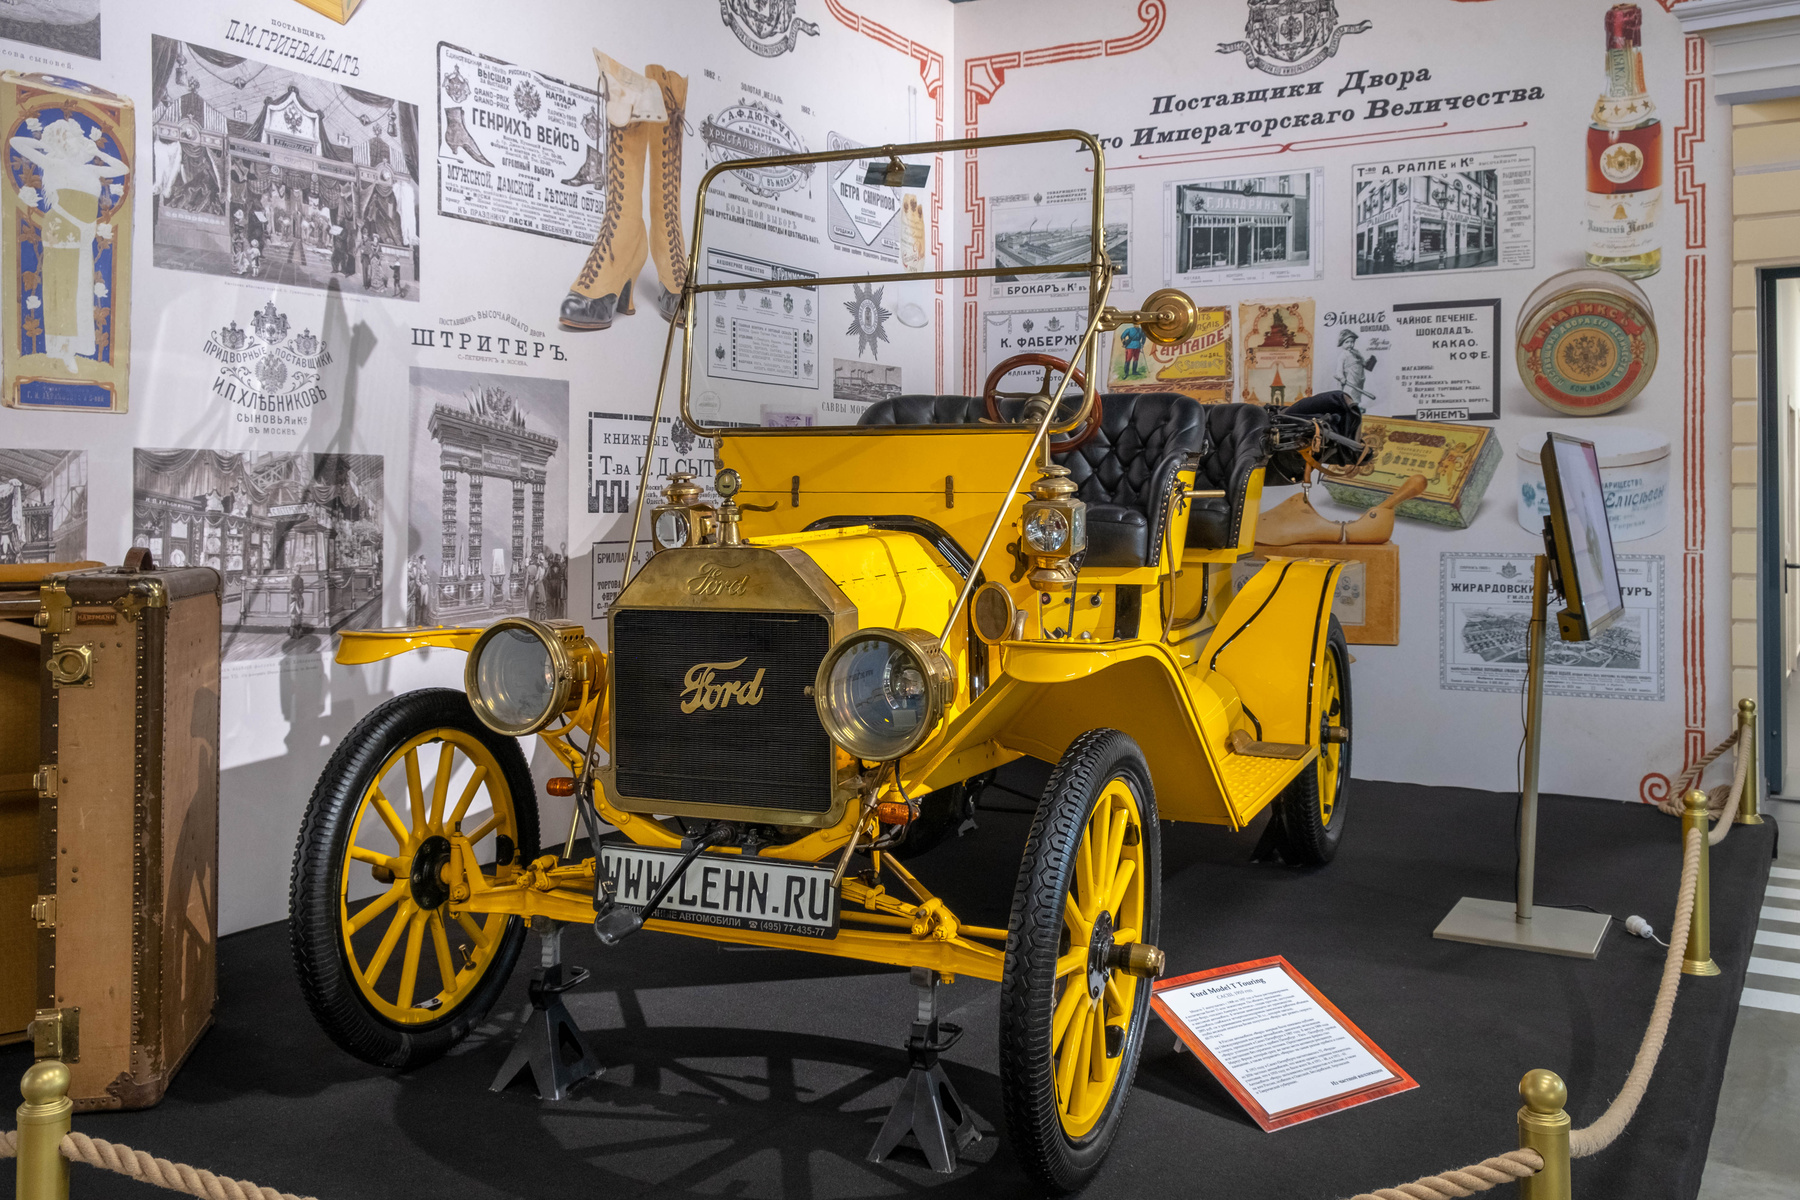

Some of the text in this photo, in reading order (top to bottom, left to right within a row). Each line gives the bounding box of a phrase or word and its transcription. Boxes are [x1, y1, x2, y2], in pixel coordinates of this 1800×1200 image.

[271, 18, 326, 40] ПОСТАВЩИКЪ
[0, 48, 25, 60] сова
[477, 67, 512, 86] ВЫСШАЯ
[474, 87, 510, 104] GRAND-PRIX
[546, 90, 577, 107] НАГРАДА
[1150, 67, 1432, 116] Поставщики Двора
[474, 96, 510, 111] GRAND-PRIX
[1076, 85, 1545, 152] Его Императорскаго Величества
[472, 107, 579, 152] ГЕНРИХЪ ВЕЙСЪ
[709, 127, 773, 158] ХРУСТАЛЬНЫЙ
[1382, 165, 1394, 175] А.
[1397, 159, 1447, 174] РАЛЛЕ
[447, 164, 493, 191] МУЖСКОЙ,
[496, 176, 534, 199] ДАМСКОЙ
[581, 196, 604, 214] ОБУВИ
[840, 182, 896, 211] ПЕТРА СМИРНОВА
[726, 203, 797, 230] БОЛЬШОЙ ВЫБОРЪ
[1007, 284, 1060, 295] БРОКАРЪ
[438, 314, 476, 327] ПОСТАВЩИКЪ
[477, 310, 529, 333] ВЫСОЧАЙШАГО
[1323, 310, 1386, 327] Эйнемъ
[1396, 313, 1478, 325] ЧАЙНОЕ ПЕЧЕНІЕ.
[1360, 324, 1392, 333] ШОКОЛАДЪ.
[1415, 326, 1473, 337] ШОКОЛАДЪ.
[411, 327, 568, 362] ШТРИТЕРЪ.
[1000, 338, 1012, 348] К.
[1432, 339, 1478, 349] КАКАО.
[203, 340, 333, 369] ПРИДВОРНЫЕ ПОСТАВЩИКИ
[1450, 351, 1490, 360] КОФЕ.
[1007, 369, 1041, 377] ИЛЛІАНТЫ
[821, 401, 847, 413] САВВЫ
[1419, 410, 1467, 420] ЭЙНЕМЪ
[603, 432, 669, 447] КНИЖНЫЕ
[674, 458, 717, 478] СЫТ
[1602, 478, 1643, 489] АРИЩЕСТВО
[597, 551, 641, 565] БРИЛЛІАЫ,
[597, 580, 621, 591] ТОРГОВА
[687, 562, 750, 596] Ford
[680, 656, 766, 714] Ford
[604, 855, 831, 922] WWW.LEHN.RU
[679, 913, 741, 927] АВТОМОБИЛИ
[760, 922, 782, 933] (495)
[783, 924, 826, 937] 77-435-77
[1190, 986, 1208, 999] Ford
[1207, 983, 1231, 995] Model
[1236, 977, 1267, 989] Touring
